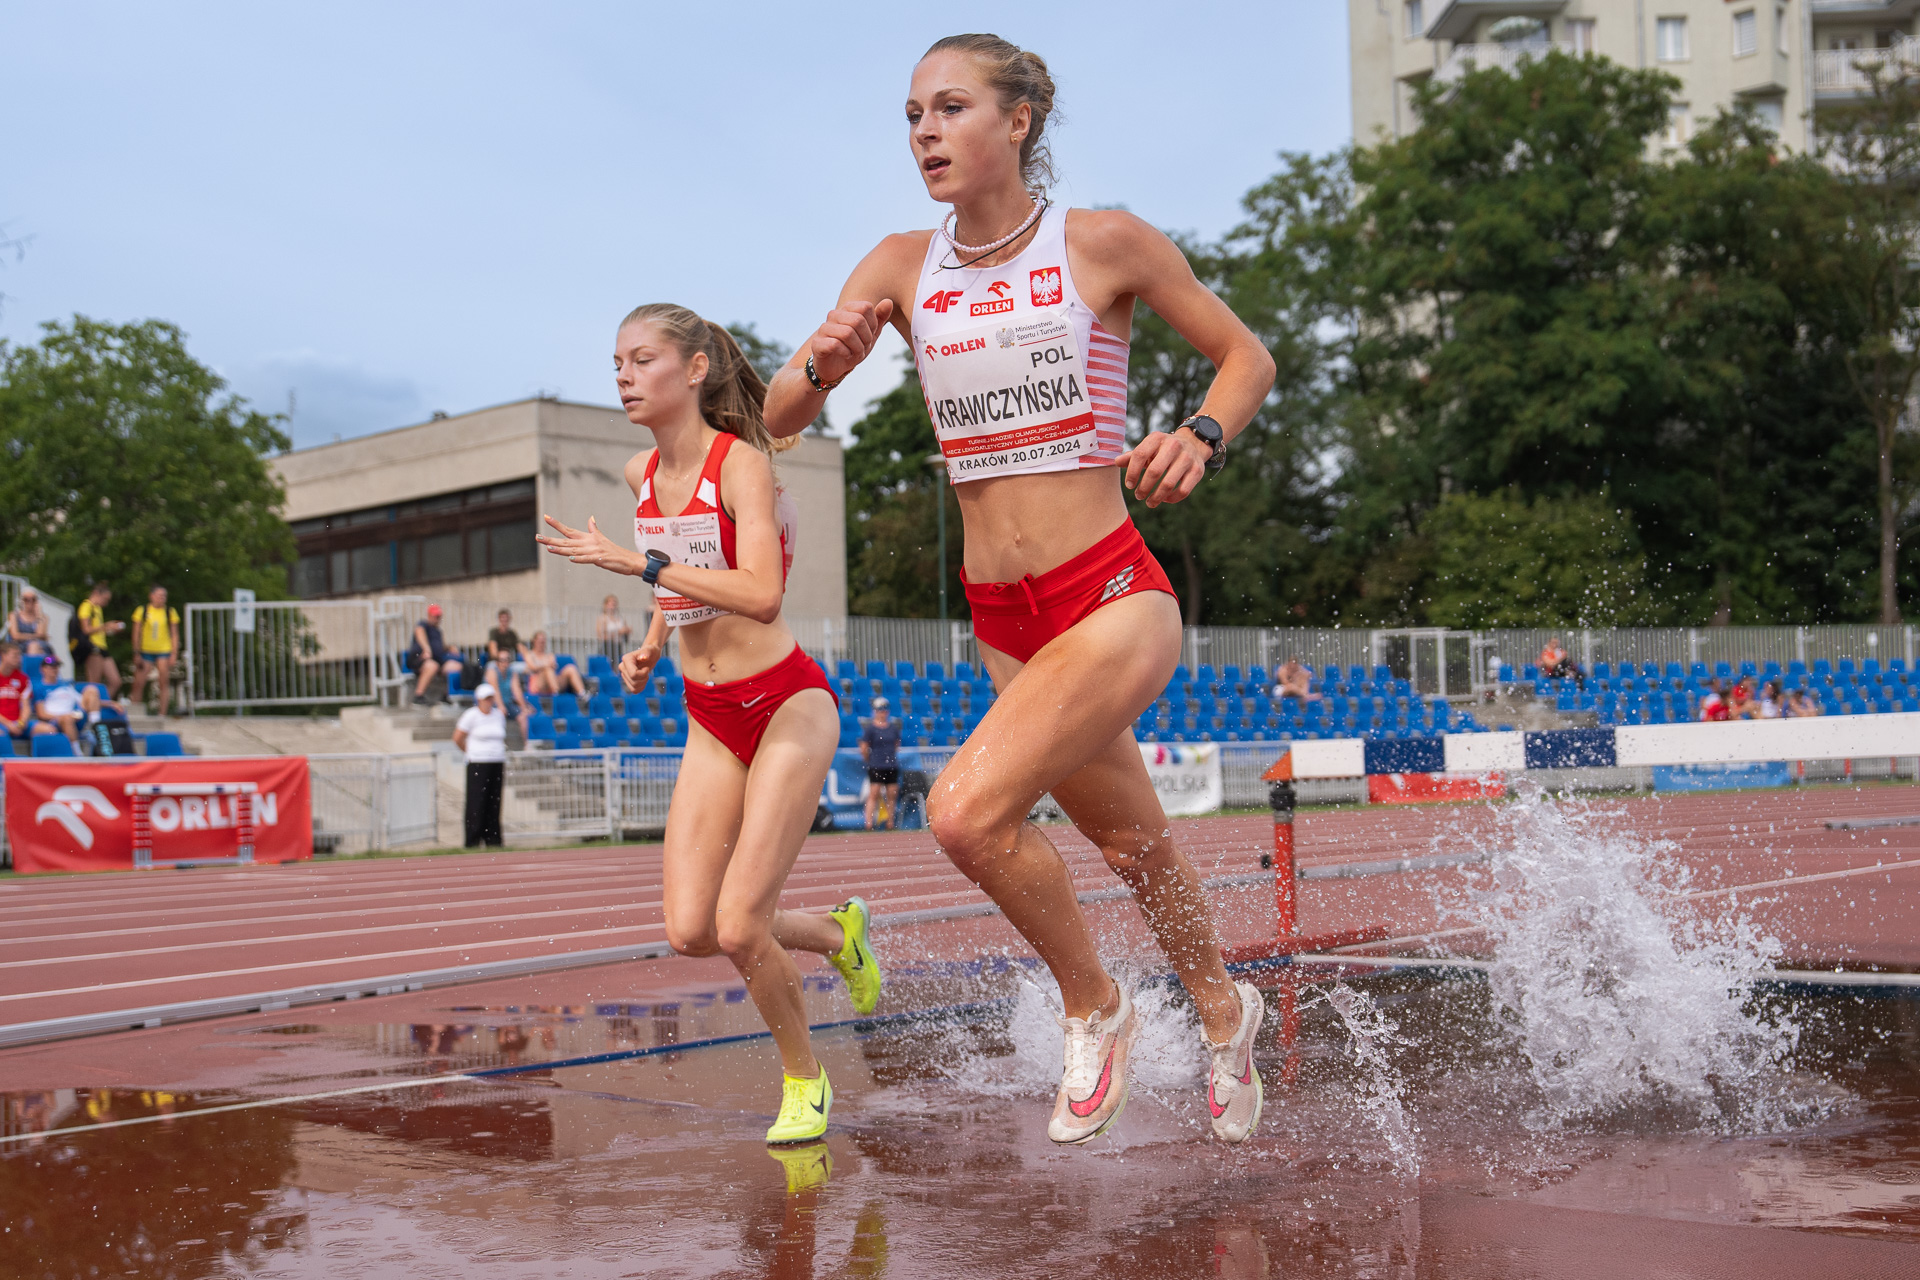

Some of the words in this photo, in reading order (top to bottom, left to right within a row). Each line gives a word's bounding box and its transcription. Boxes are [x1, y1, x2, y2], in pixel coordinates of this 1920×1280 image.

[923, 290, 964, 313] 4F
[972, 301, 1012, 315] ORLEN
[1015, 321, 1053, 333] Ministerstwo
[1016, 332, 1036, 341] Sportu
[1040, 323, 1067, 336] Turystyki
[940, 337, 987, 357] ORLEN
[1030, 345, 1074, 368] POL
[934, 374, 1084, 429] KRAWCZYŃSKA
[968, 437, 991, 446] TURNIEJ
[1015, 424, 1060, 438] OLIMPIJSKICH
[1014, 437, 1029, 446] U23
[959, 454, 1008, 471] KRAKÓW
[1011, 439, 1081, 463] 20.07.2024
[689, 540, 717, 554] HUN
